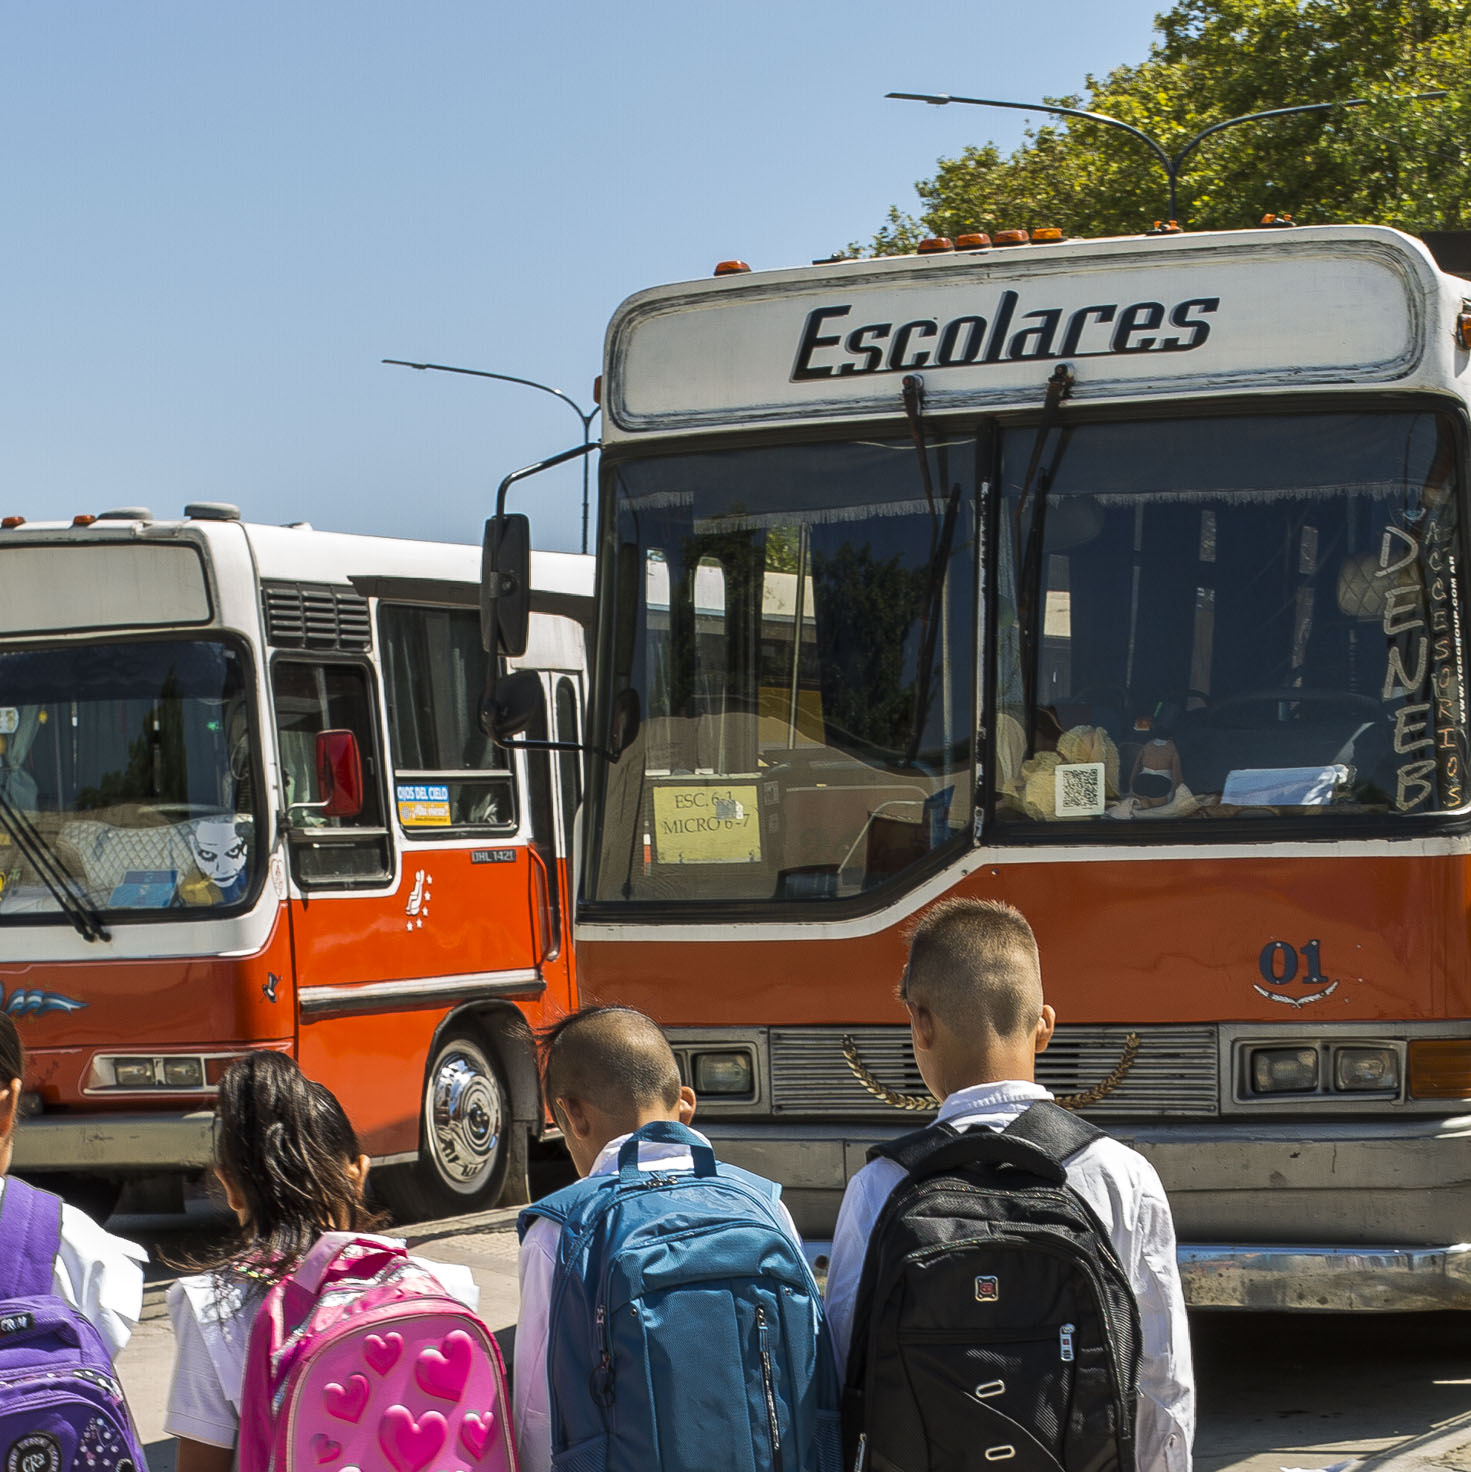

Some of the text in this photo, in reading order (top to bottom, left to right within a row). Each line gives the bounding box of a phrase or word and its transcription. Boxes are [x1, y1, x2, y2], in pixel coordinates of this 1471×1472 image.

[789, 289, 1220, 383] Escolares
[1375, 525, 1437, 812] DENEB
[673, 792, 709, 809] ESC.
[663, 816, 721, 835] MICRO
[1258, 938, 1330, 986] 01
